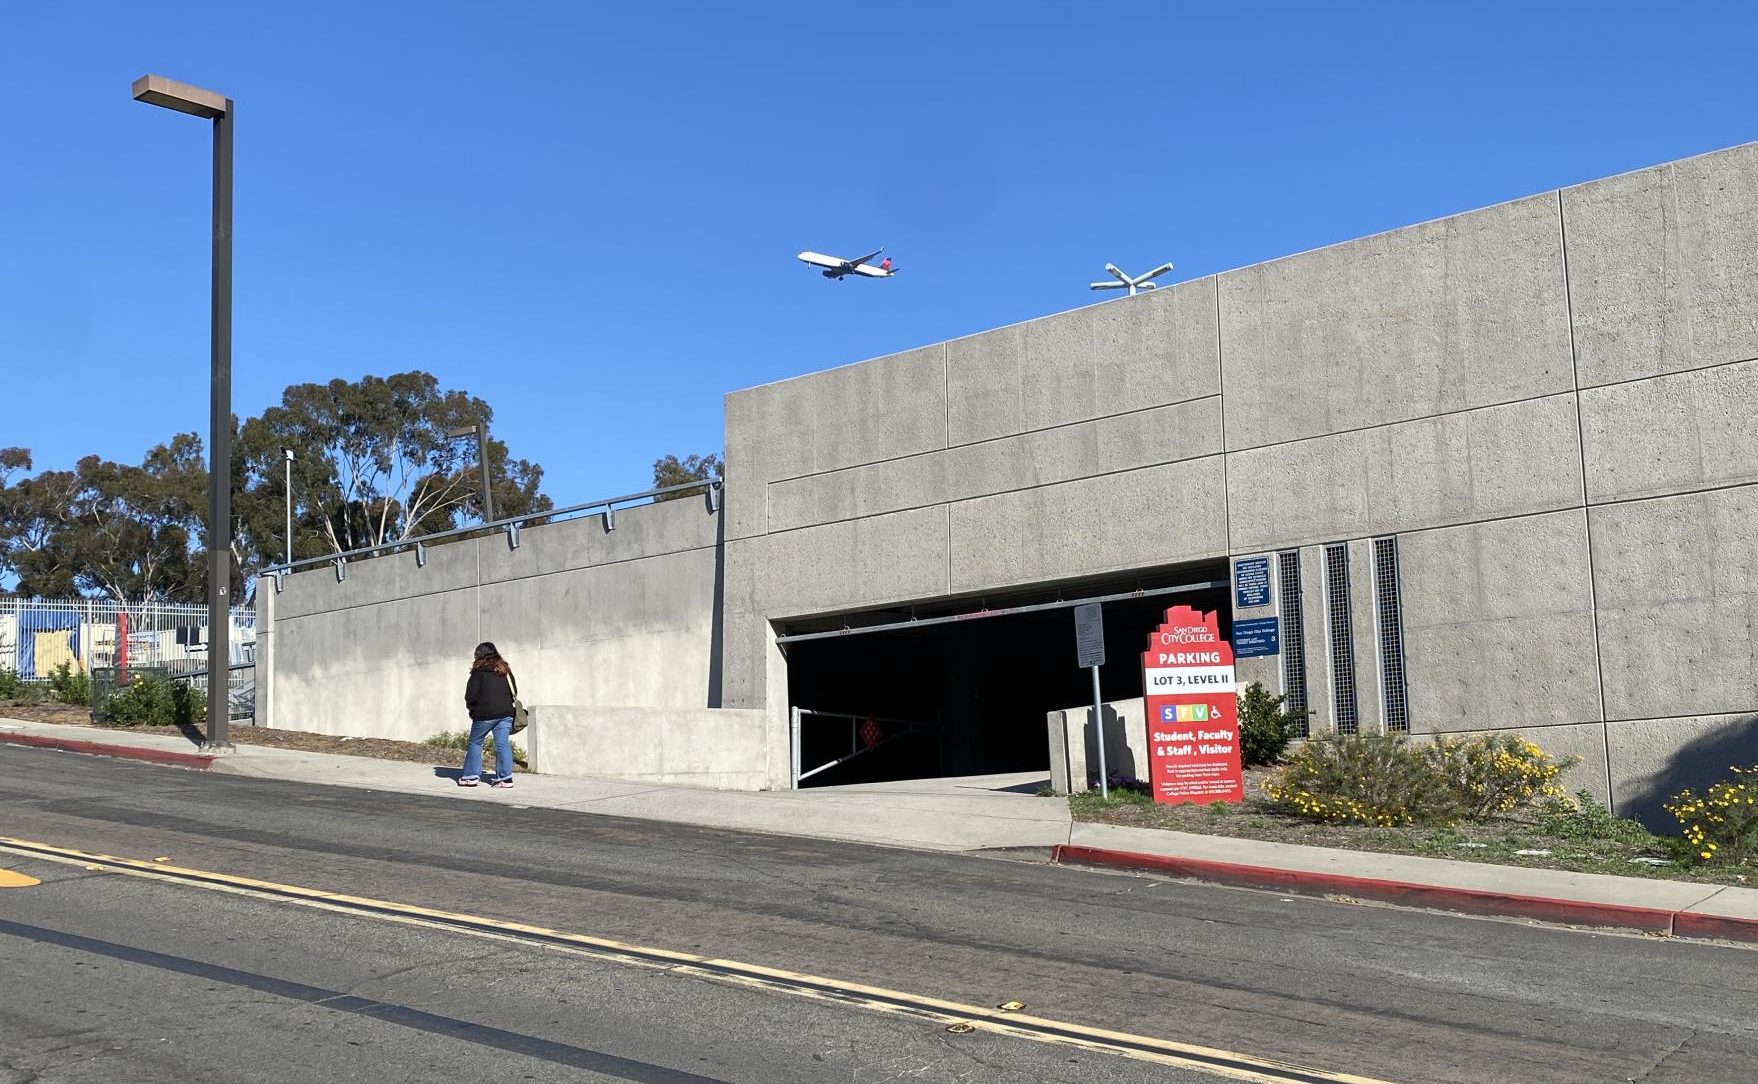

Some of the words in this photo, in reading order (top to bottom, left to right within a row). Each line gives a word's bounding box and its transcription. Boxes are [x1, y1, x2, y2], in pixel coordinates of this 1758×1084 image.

[1187, 626, 1207, 634] DIEGO
[1161, 633, 1180, 645] CITY
[1179, 633, 1215, 644] COLLEGE
[1159, 652, 1220, 664] PARKING
[1154, 676, 1173, 685] LOT
[1176, 676, 1185, 686] 3,
[1188, 675, 1219, 684] LEVEL
[1221, 674, 1228, 683] II
[1164, 708, 1173, 720] S
[1181, 707, 1189, 719] F
[1195, 706, 1205, 718] V
[1153, 731, 1196, 742] Student,
[1198, 730, 1233, 741] Faculty
[1157, 746, 1165, 756] &
[1166, 745, 1192, 756] Staff
[1199, 743, 1233, 754] Visitor
